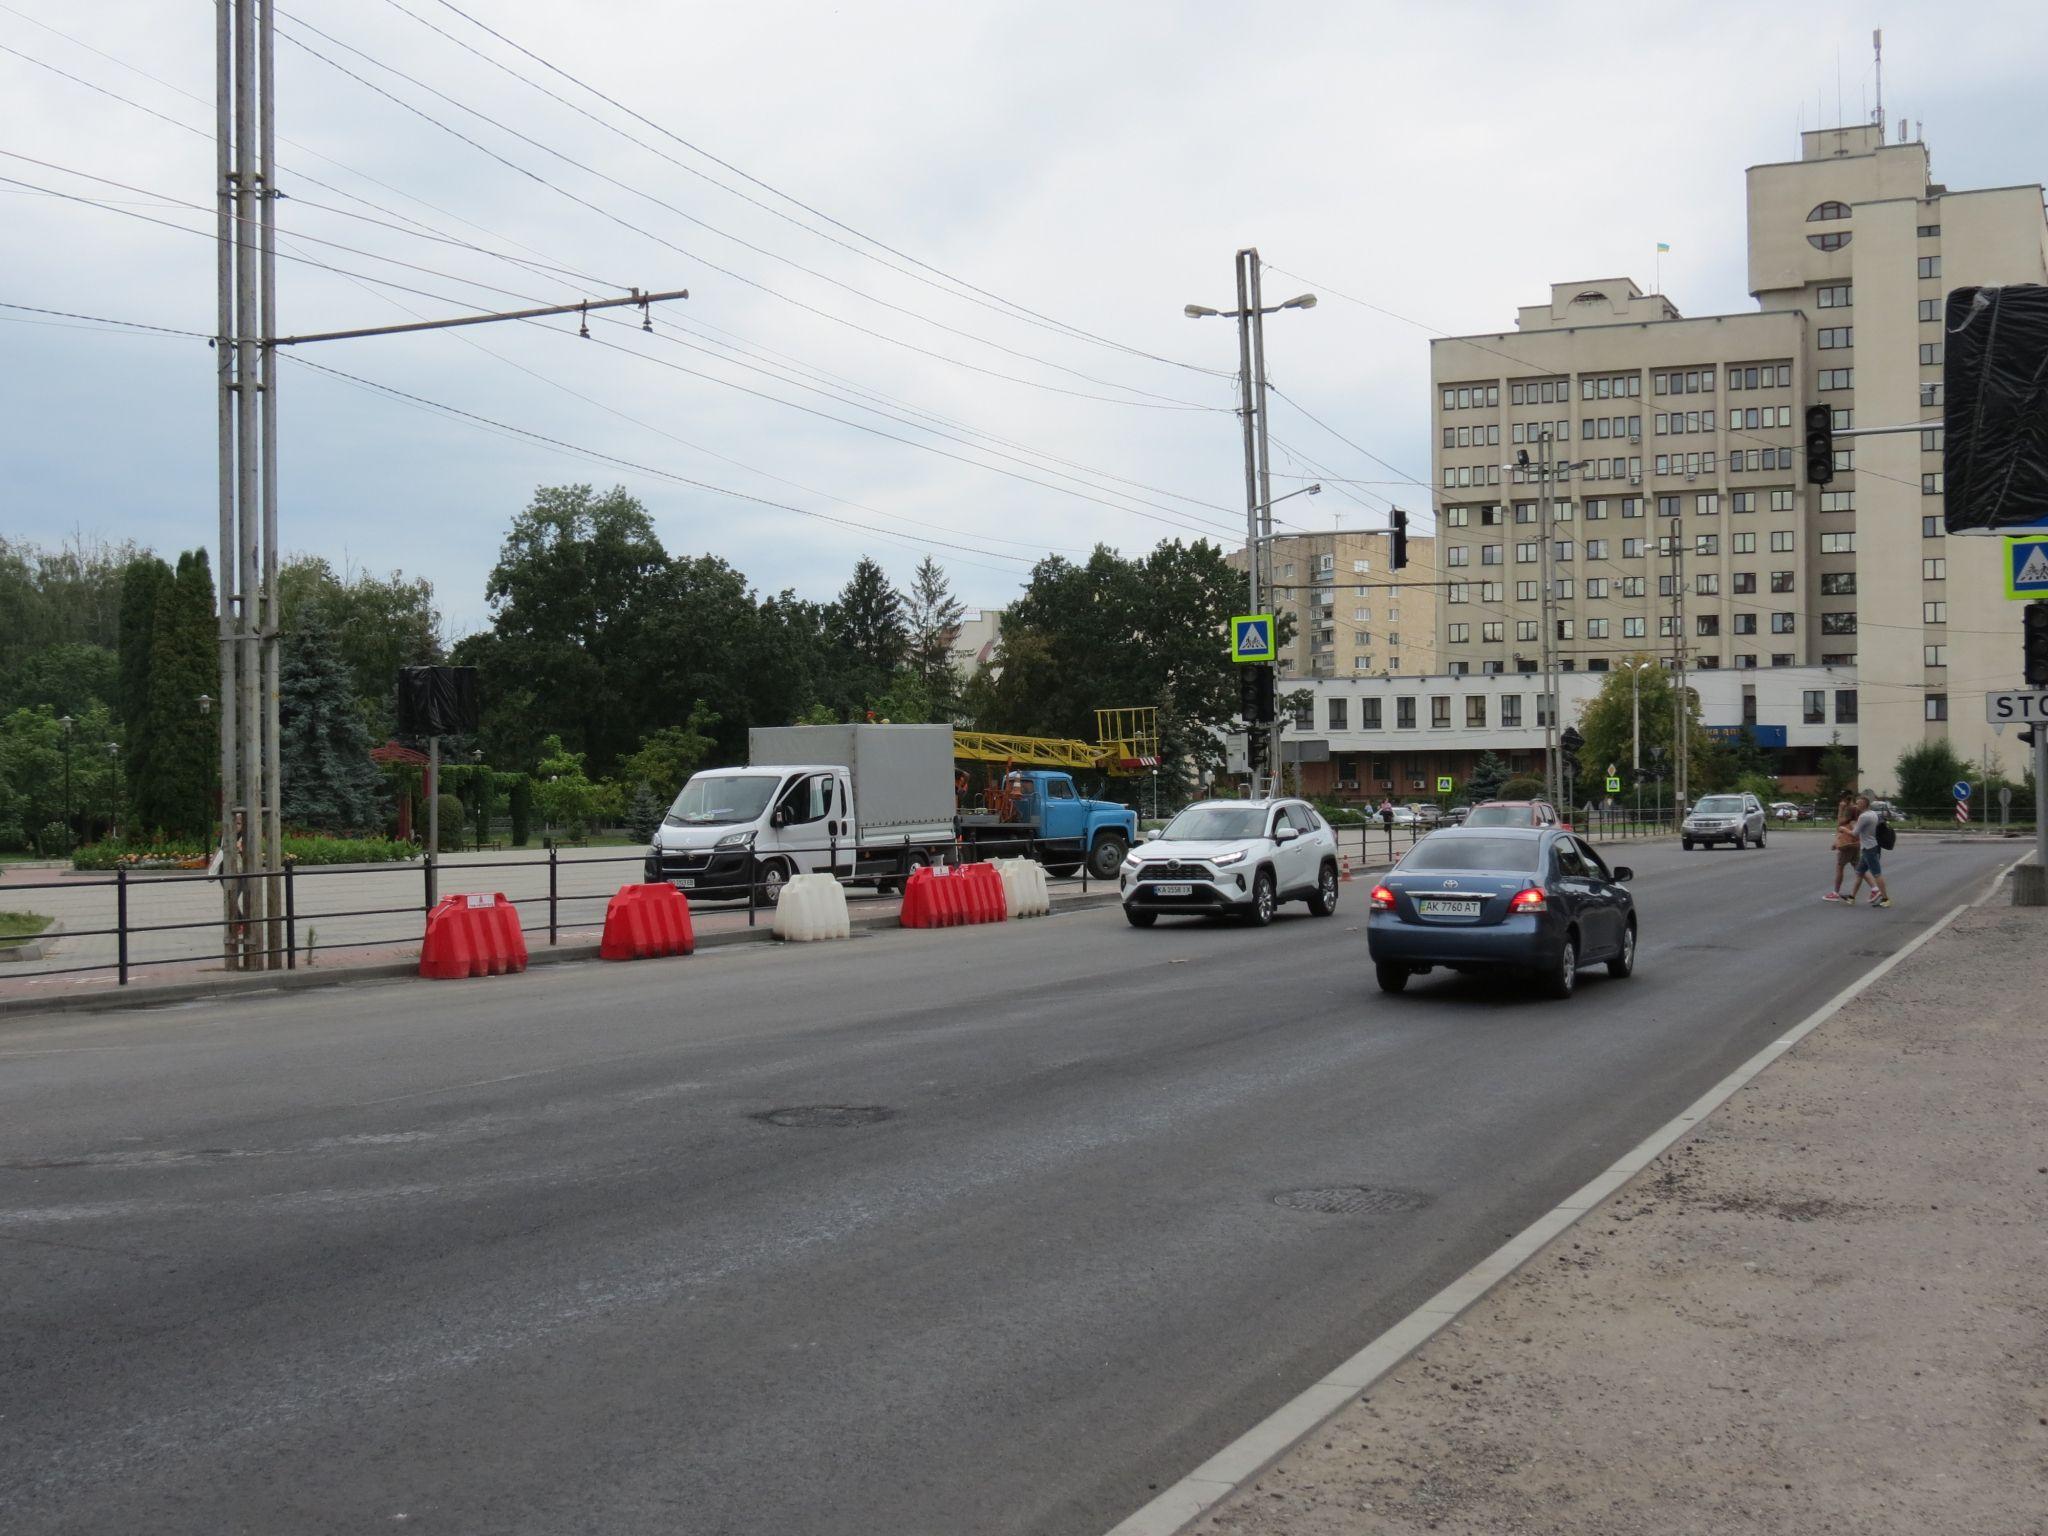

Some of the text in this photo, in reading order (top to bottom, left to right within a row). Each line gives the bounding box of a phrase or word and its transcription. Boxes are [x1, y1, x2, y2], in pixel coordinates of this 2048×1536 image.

[1426, 902, 1478, 912] AK 7760 AT
